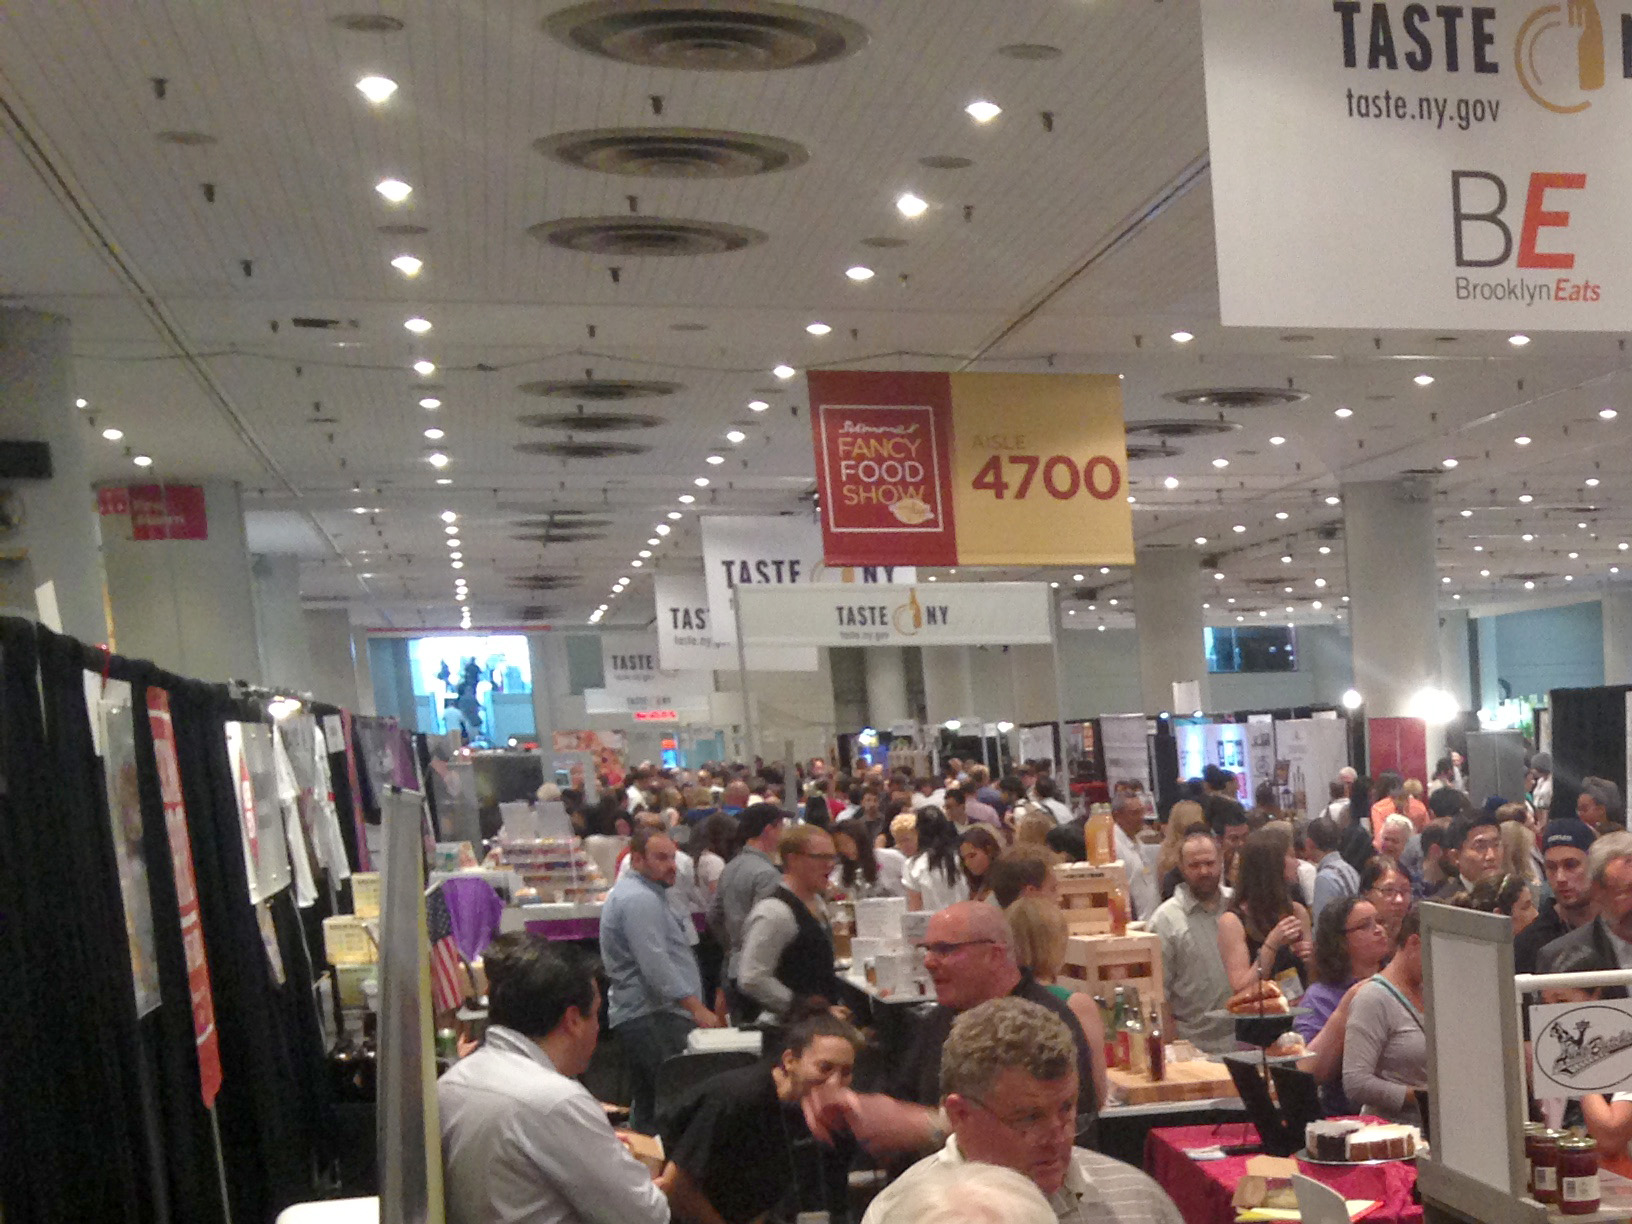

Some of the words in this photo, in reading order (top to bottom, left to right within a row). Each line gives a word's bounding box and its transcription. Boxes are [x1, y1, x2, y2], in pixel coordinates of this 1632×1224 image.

[1333, 1, 1499, 73] TASTE
[1346, 88, 1499, 130] taste.ny.gov
[1451, 170, 1587, 268] BE
[838, 437, 922, 459] FANCY
[972, 434, 1026, 449] AISLE
[840, 461, 925, 482] FOOD
[971, 455, 1122, 500] 4700
[843, 485, 926, 505] SHOW
[723, 560, 800, 588] TASTE
[670, 608, 709, 630] TAS
[836, 606, 888, 626] TASTE
[926, 605, 948, 624] NY
[612, 655, 653, 670] TASTE
